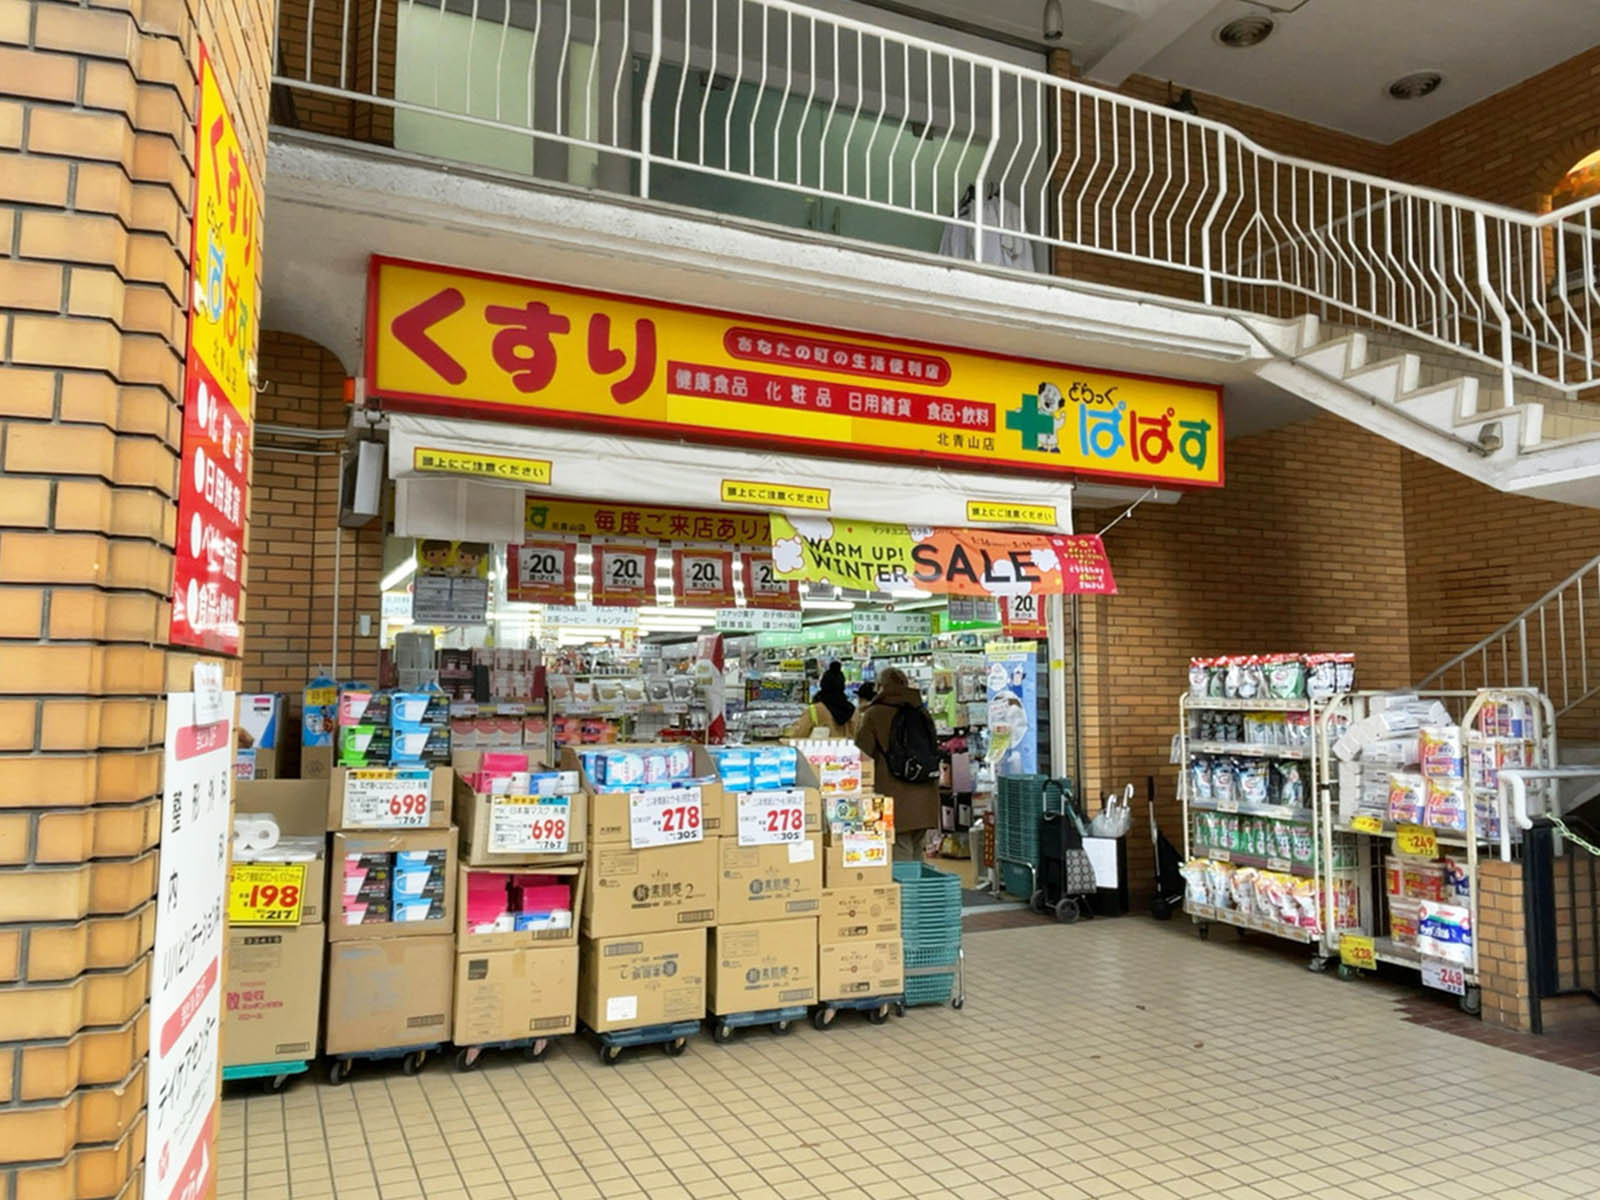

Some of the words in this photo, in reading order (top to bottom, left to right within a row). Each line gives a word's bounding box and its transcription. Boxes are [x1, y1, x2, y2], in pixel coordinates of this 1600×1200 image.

[210, 113, 253, 268] くすり
[391, 287, 658, 405] くすり
[675, 368, 749, 398] 健康食品
[766, 381, 832, 408] 化粧品
[848, 391, 912, 418] 日用雑貨
[936, 431, 996, 451] 北青山店
[1079, 400, 1212, 471] ぱぱす
[422, 455, 544, 477] 頭上にご注意ください
[803, 534, 863, 559] WARM
[871, 545, 904, 561] UP!
[808, 547, 909, 583] WINTER
[911, 543, 1041, 583] SALE
[389, 793, 427, 816] 698
[532, 819, 566, 840] 698
[661, 805, 700, 832] 278
[767, 808, 803, 832] 278
[249, 884, 300, 909] 198
[265, 909, 294, 920] 217
